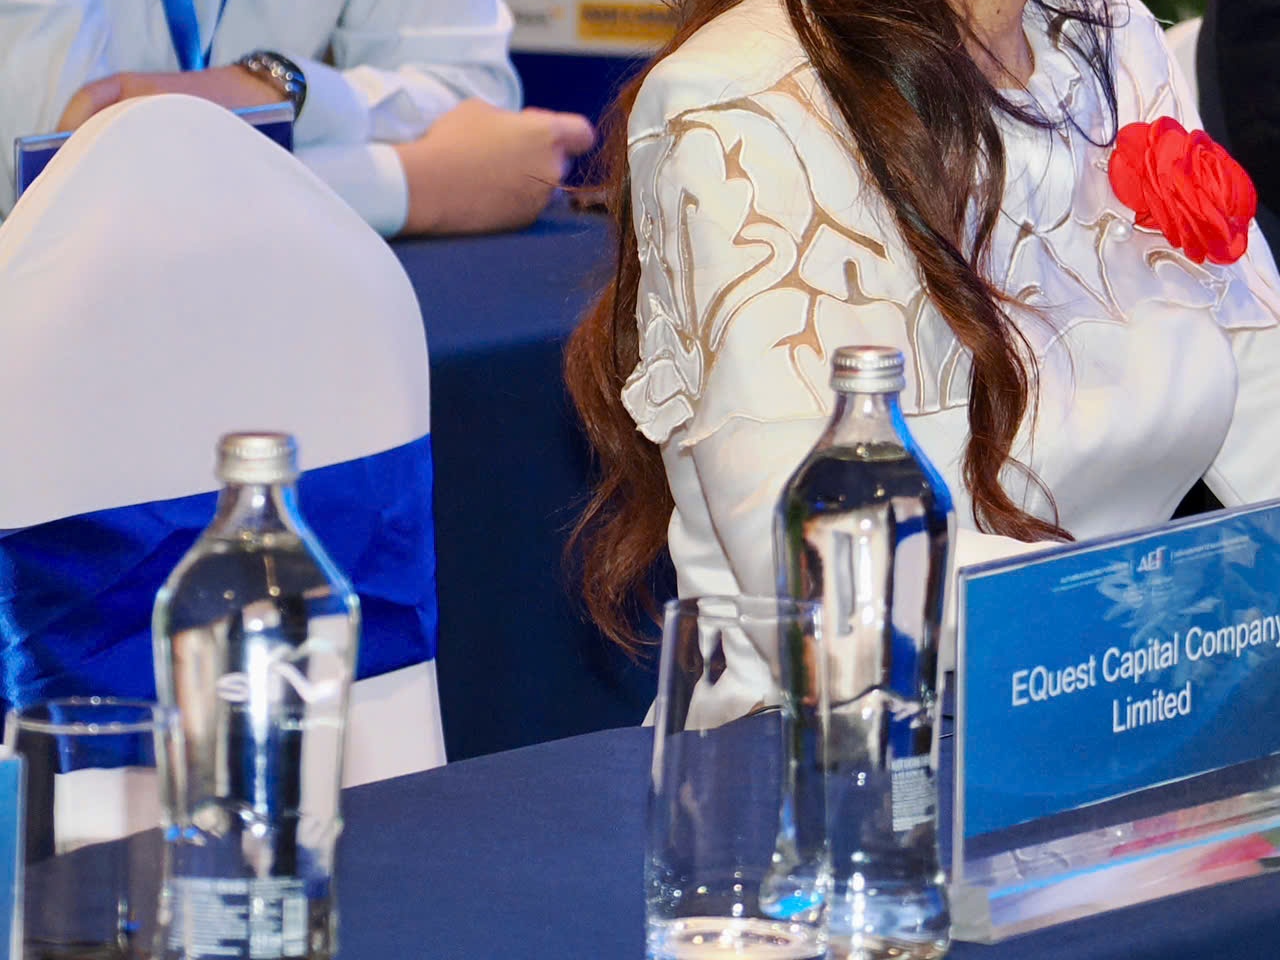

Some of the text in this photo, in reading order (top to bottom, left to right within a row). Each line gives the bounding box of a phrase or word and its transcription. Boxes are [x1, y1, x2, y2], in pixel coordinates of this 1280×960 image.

[1011, 655, 1096, 707] EQuest
[1102, 632, 1178, 684] Capital
[1112, 681, 1192, 733] Limited
